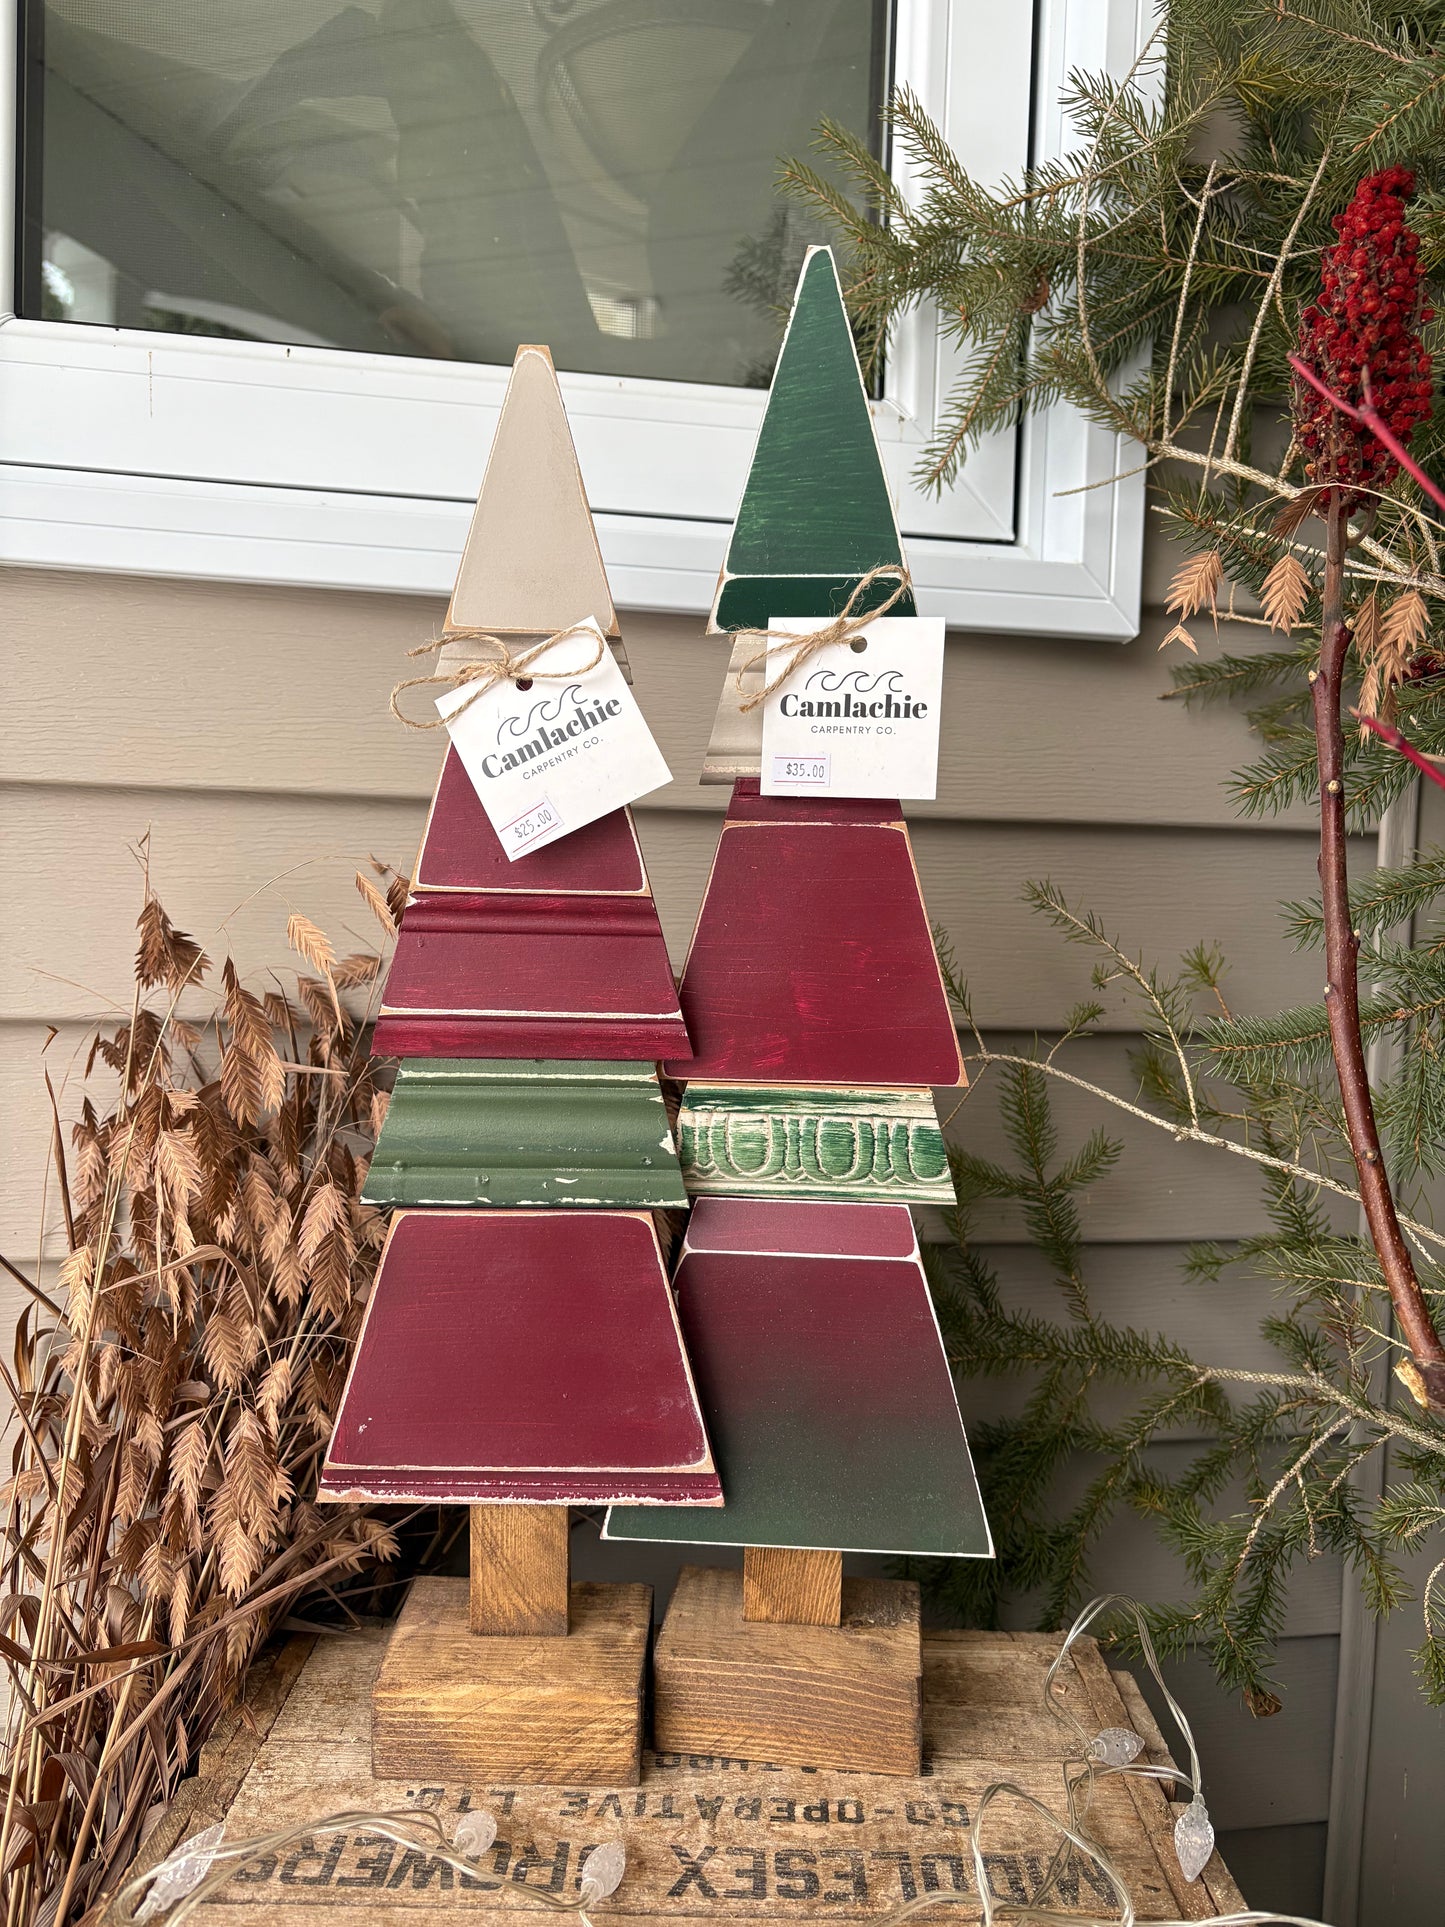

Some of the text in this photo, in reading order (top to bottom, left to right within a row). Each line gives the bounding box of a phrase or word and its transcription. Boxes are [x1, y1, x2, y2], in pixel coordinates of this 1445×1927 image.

[780, 693, 928, 720] Camlachie
[481, 698, 623, 779] Camlachie
[810, 725, 897, 735] CARPENTRY CO.
[522, 736, 604, 780] CARPENTRY CO.
[785, 762, 825, 779] $35.00
[514, 808, 553, 839] $25.00
[406, 1787, 971, 1828] CO-OPERATIVE LTD.
